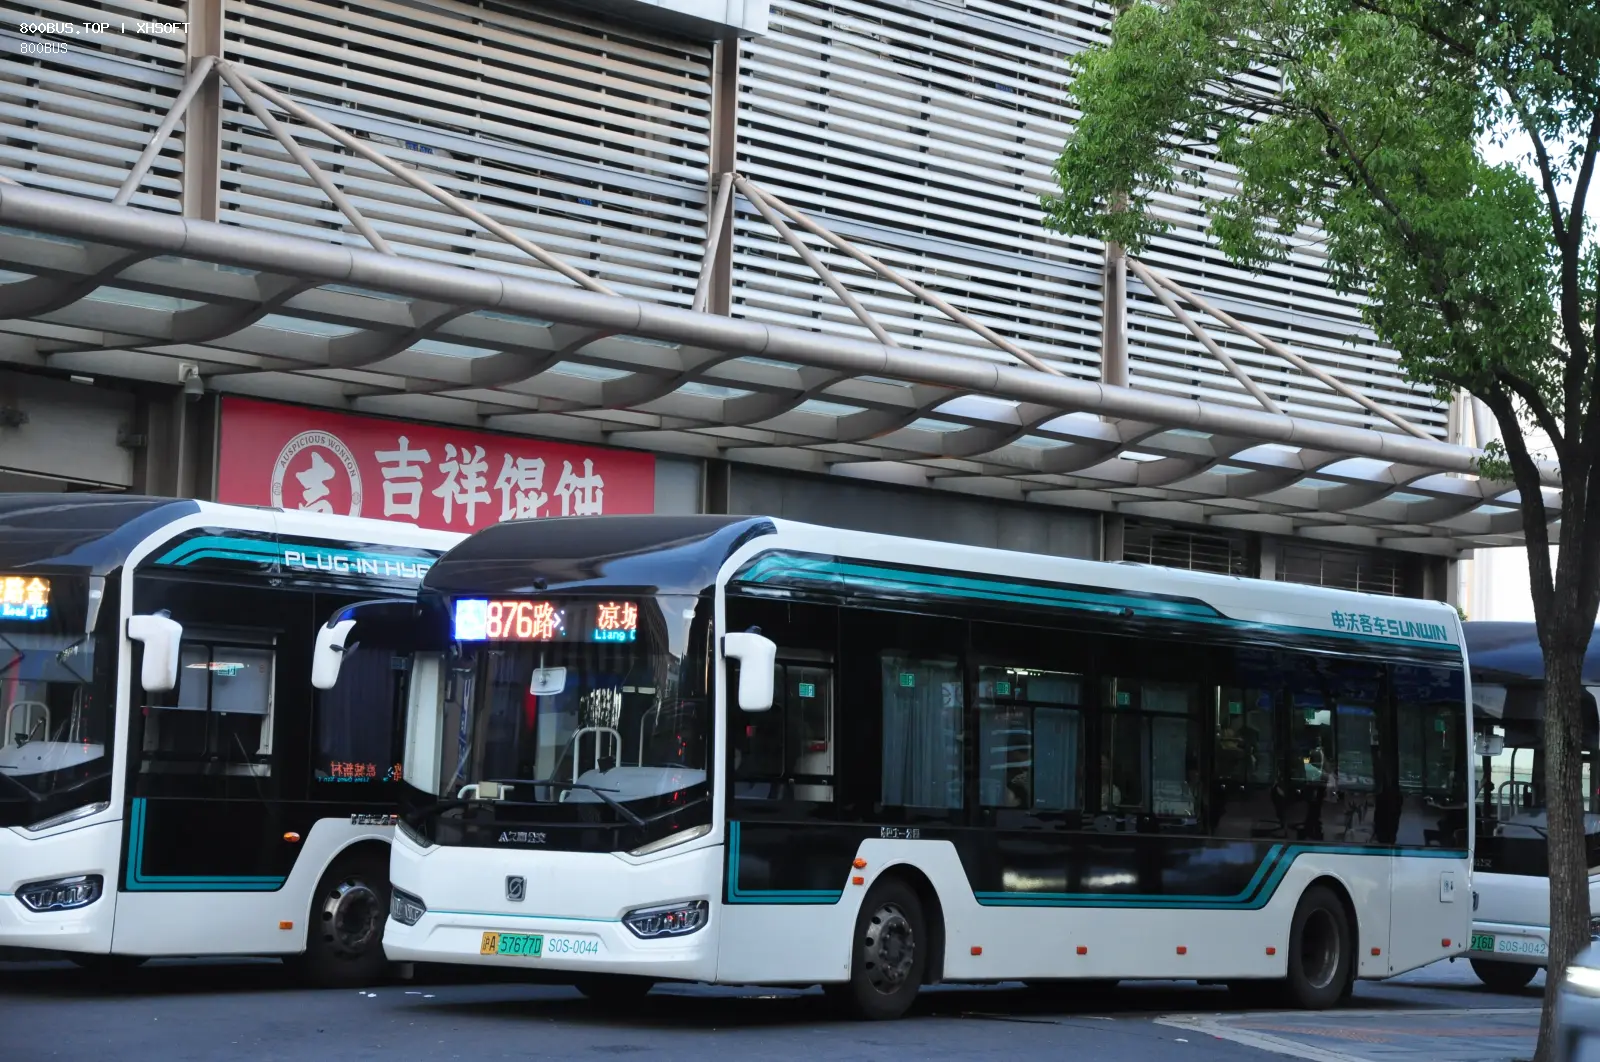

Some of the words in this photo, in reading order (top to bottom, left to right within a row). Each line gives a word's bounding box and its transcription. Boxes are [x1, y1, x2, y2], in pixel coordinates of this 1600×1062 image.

[279, 435, 326, 469] AUSPICIOUS
[328, 438, 357, 478] WONTON
[374, 435, 604, 527] 吉祥馄饨
[284, 550, 378, 575] PLUG-IN
[486, 601, 554, 639] 876路
[1386, 619, 1448, 641] SUNWIN
[595, 629, 625, 641] Liang
[500, 936, 542, 955] 57677D
